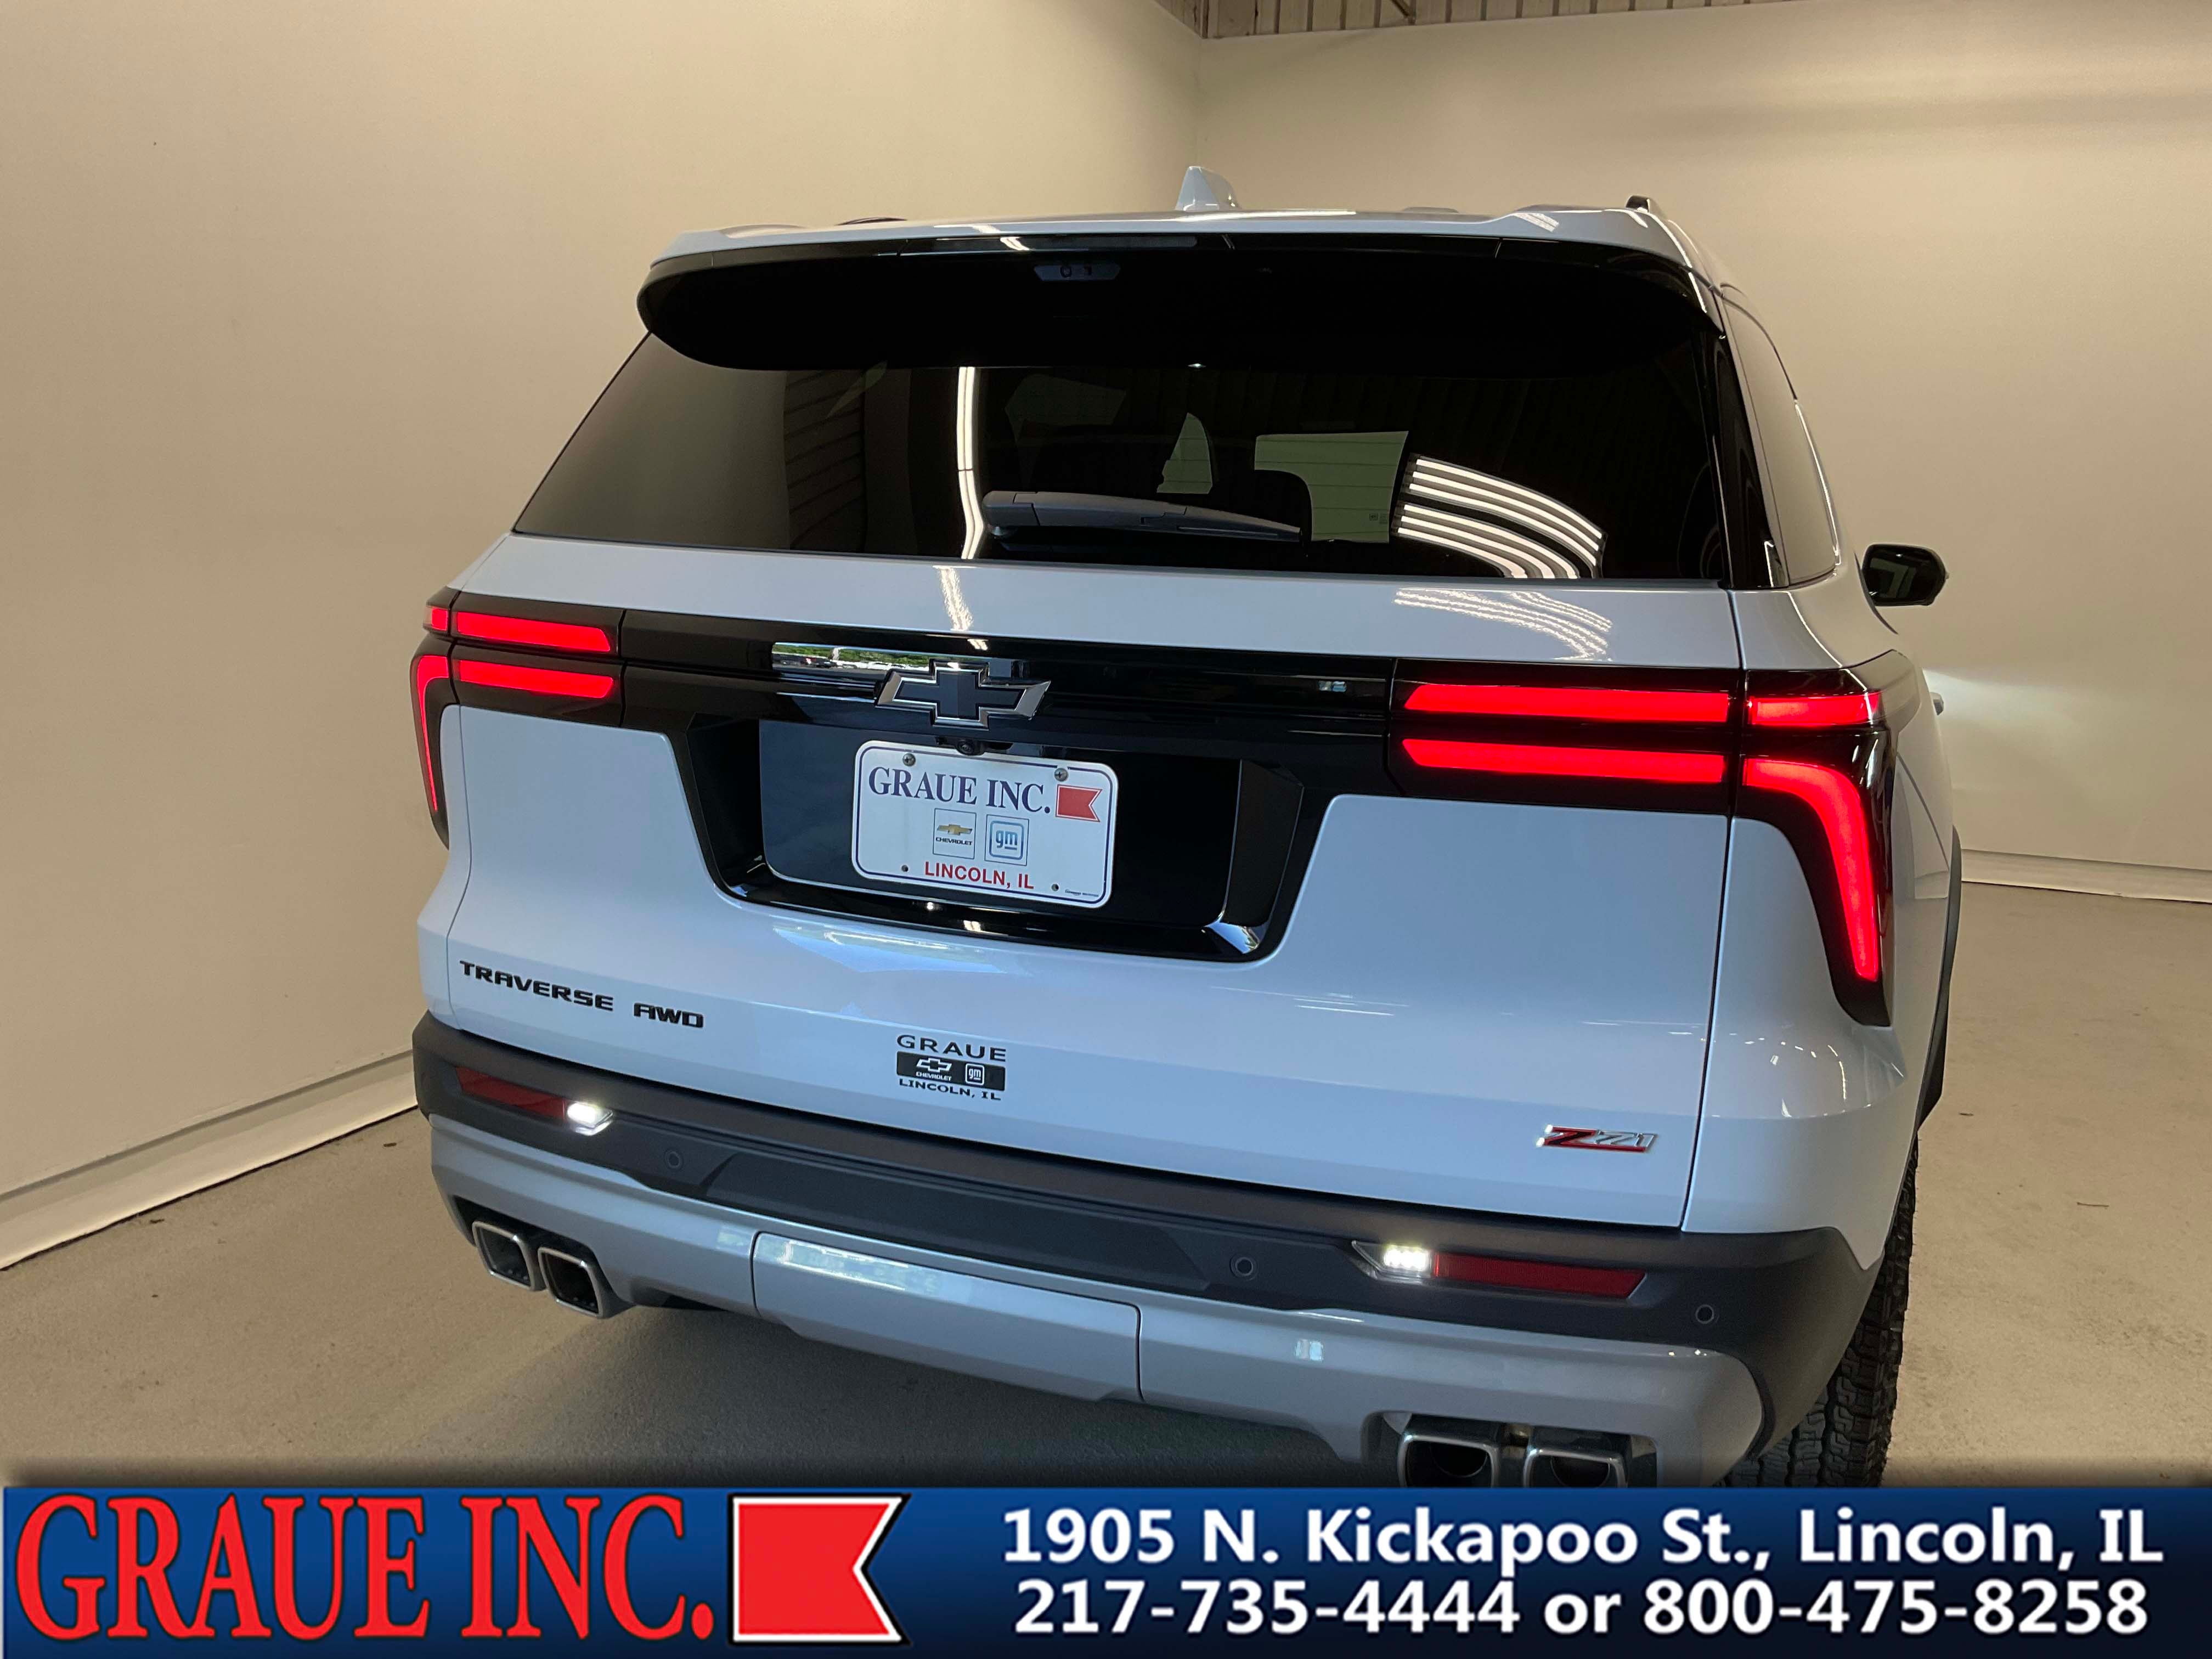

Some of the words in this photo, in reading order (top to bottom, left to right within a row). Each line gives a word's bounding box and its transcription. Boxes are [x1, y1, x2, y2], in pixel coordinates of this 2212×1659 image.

[868, 766, 977, 805] GRAUE
[985, 779, 1051, 814] INC.
[935, 837, 973, 846] CHEVROLET
[995, 830, 1018, 850] gm
[925, 862, 1010, 889] LINCOLN,
[1018, 874, 1034, 889] IL
[459, 960, 613, 1012] TRAVERSE
[634, 1002, 704, 1029] AWD
[896, 1035, 1006, 1062] GRAUE
[916, 1071, 952, 1081] CHEVROLET
[968, 1068, 981, 1081] gm
[899, 1078, 975, 1098] LINCOLN,
[981, 1091, 1001, 1101] IL
[1536, 1124, 1657, 1153] Z71
